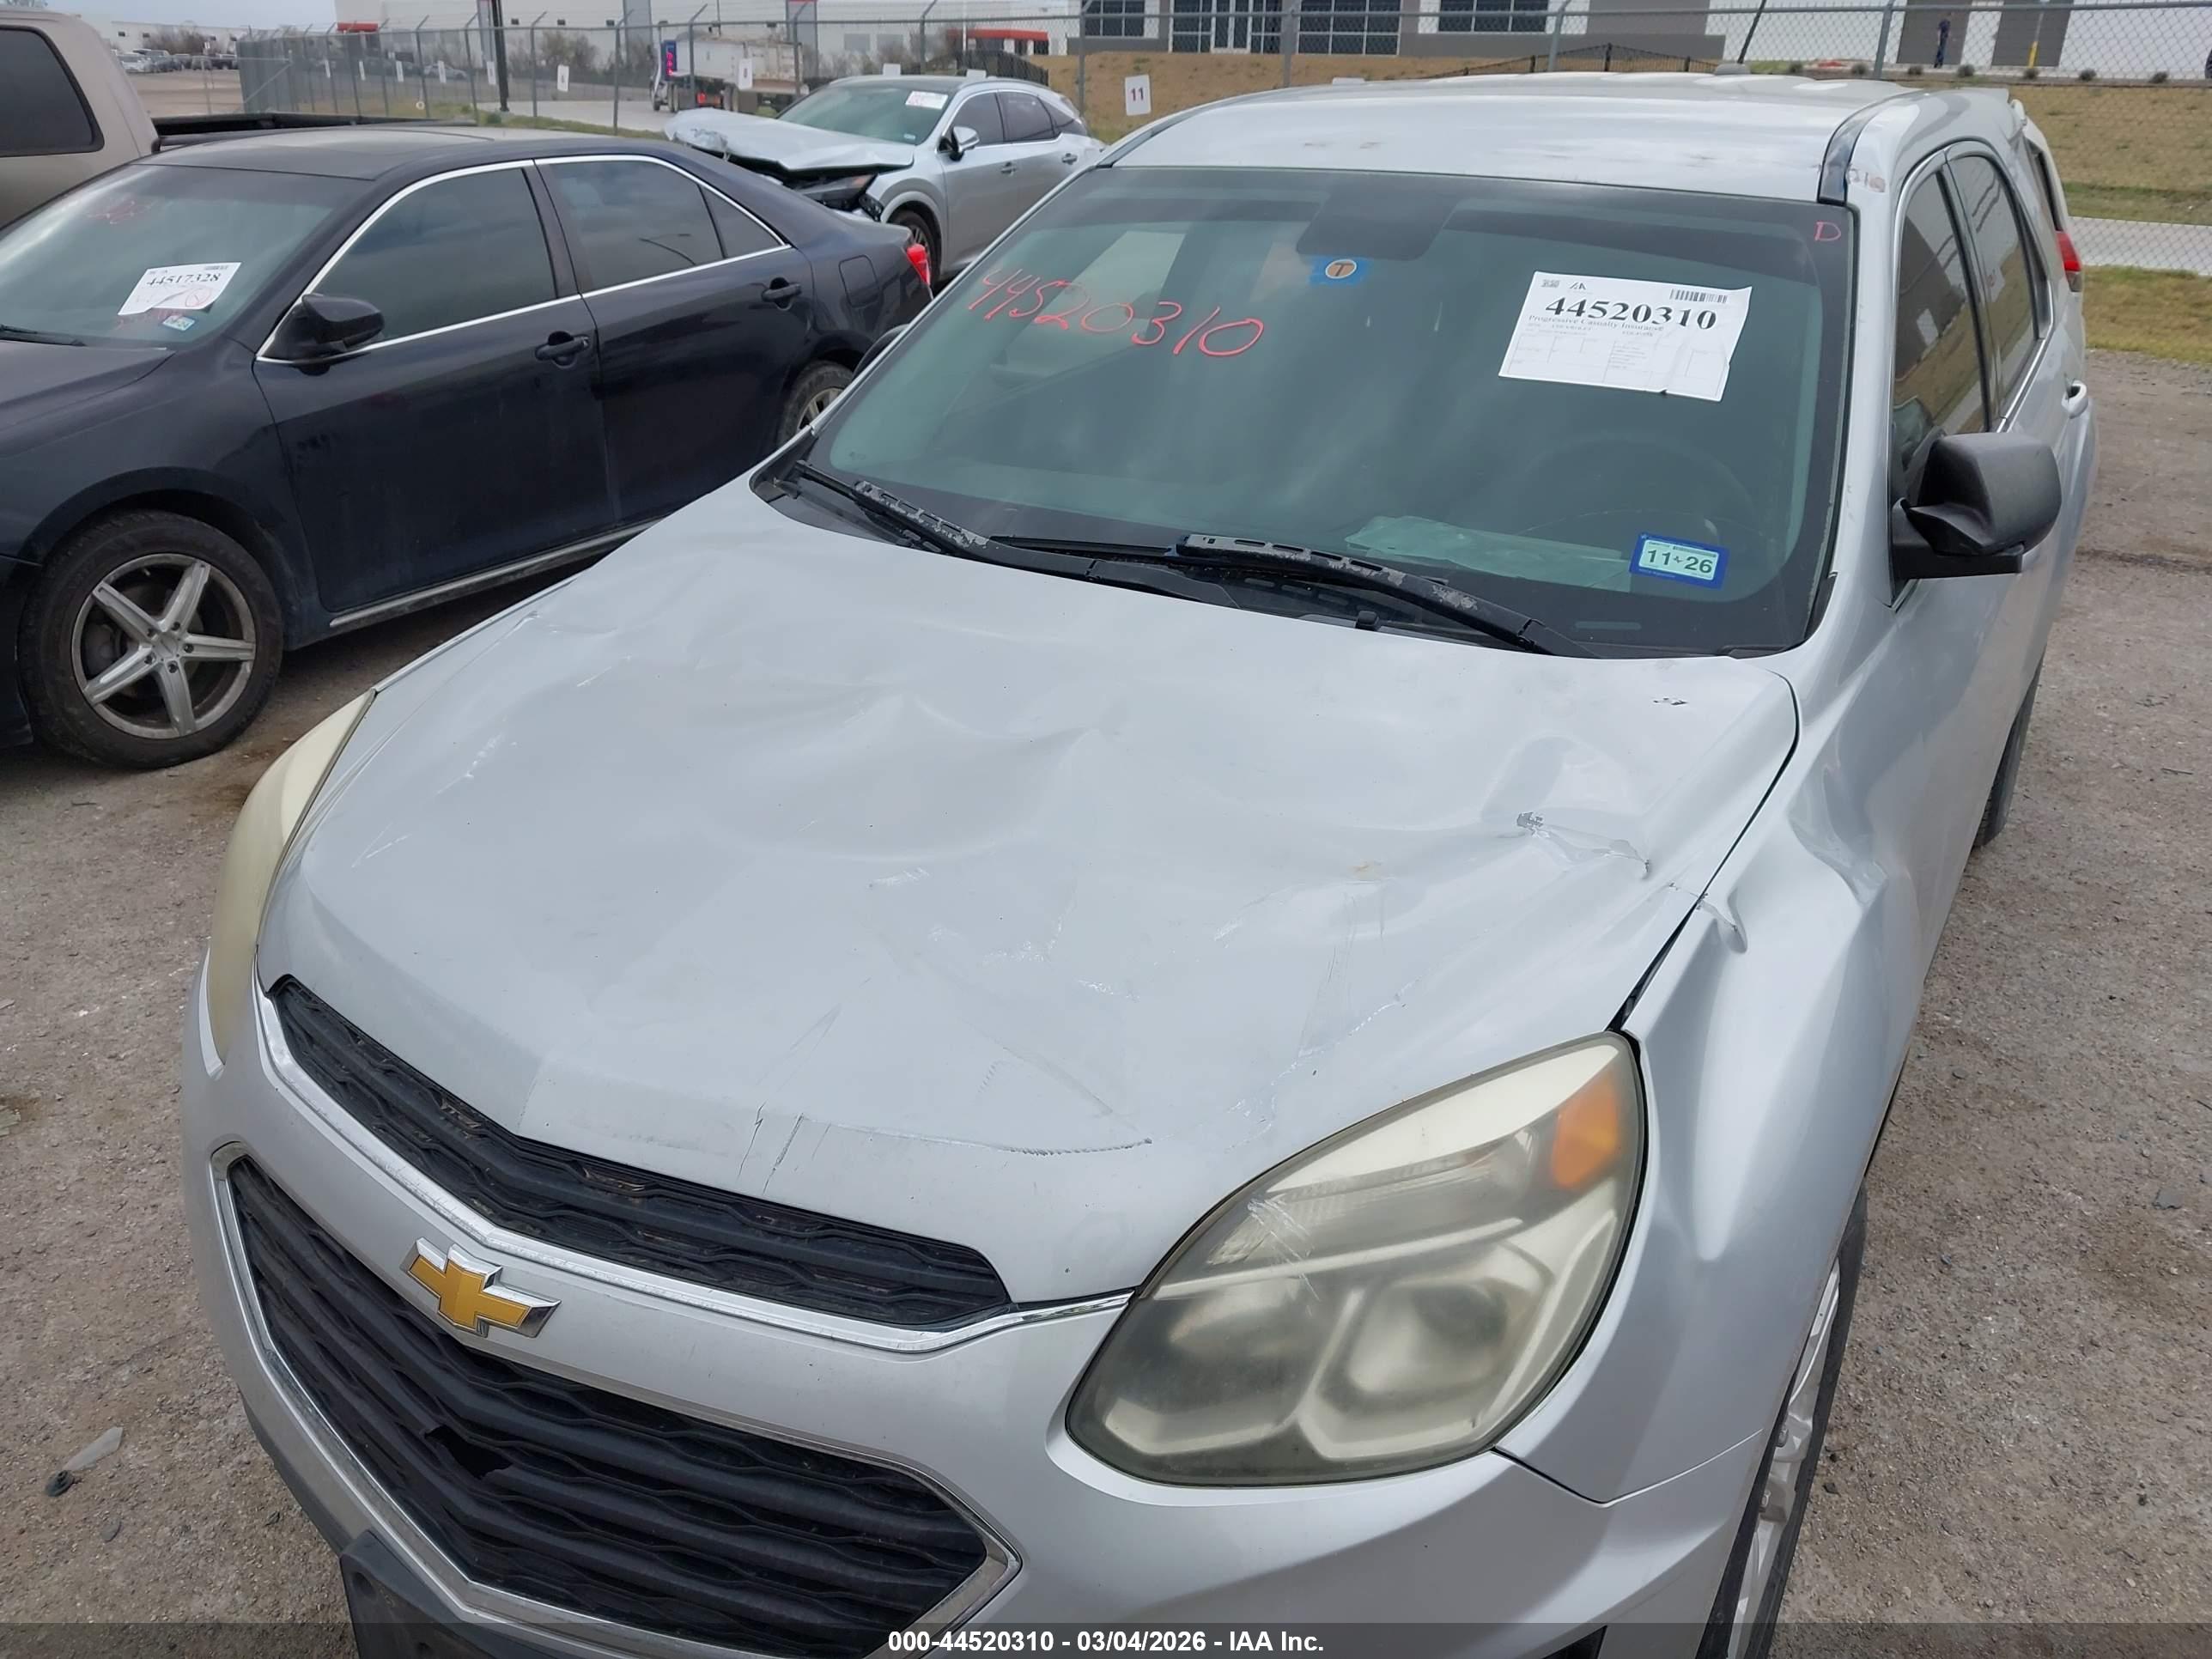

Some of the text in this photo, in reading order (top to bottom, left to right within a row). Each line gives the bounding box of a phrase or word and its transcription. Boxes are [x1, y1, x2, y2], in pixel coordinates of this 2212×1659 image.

[1130, 87, 1144, 101] 11
[1814, 221, 1842, 241] D
[146, 272, 222, 287] 44517328
[968, 268, 1264, 356] 44520310
[1545, 296, 1717, 331] 44520310
[1684, 556, 1714, 574] 26
